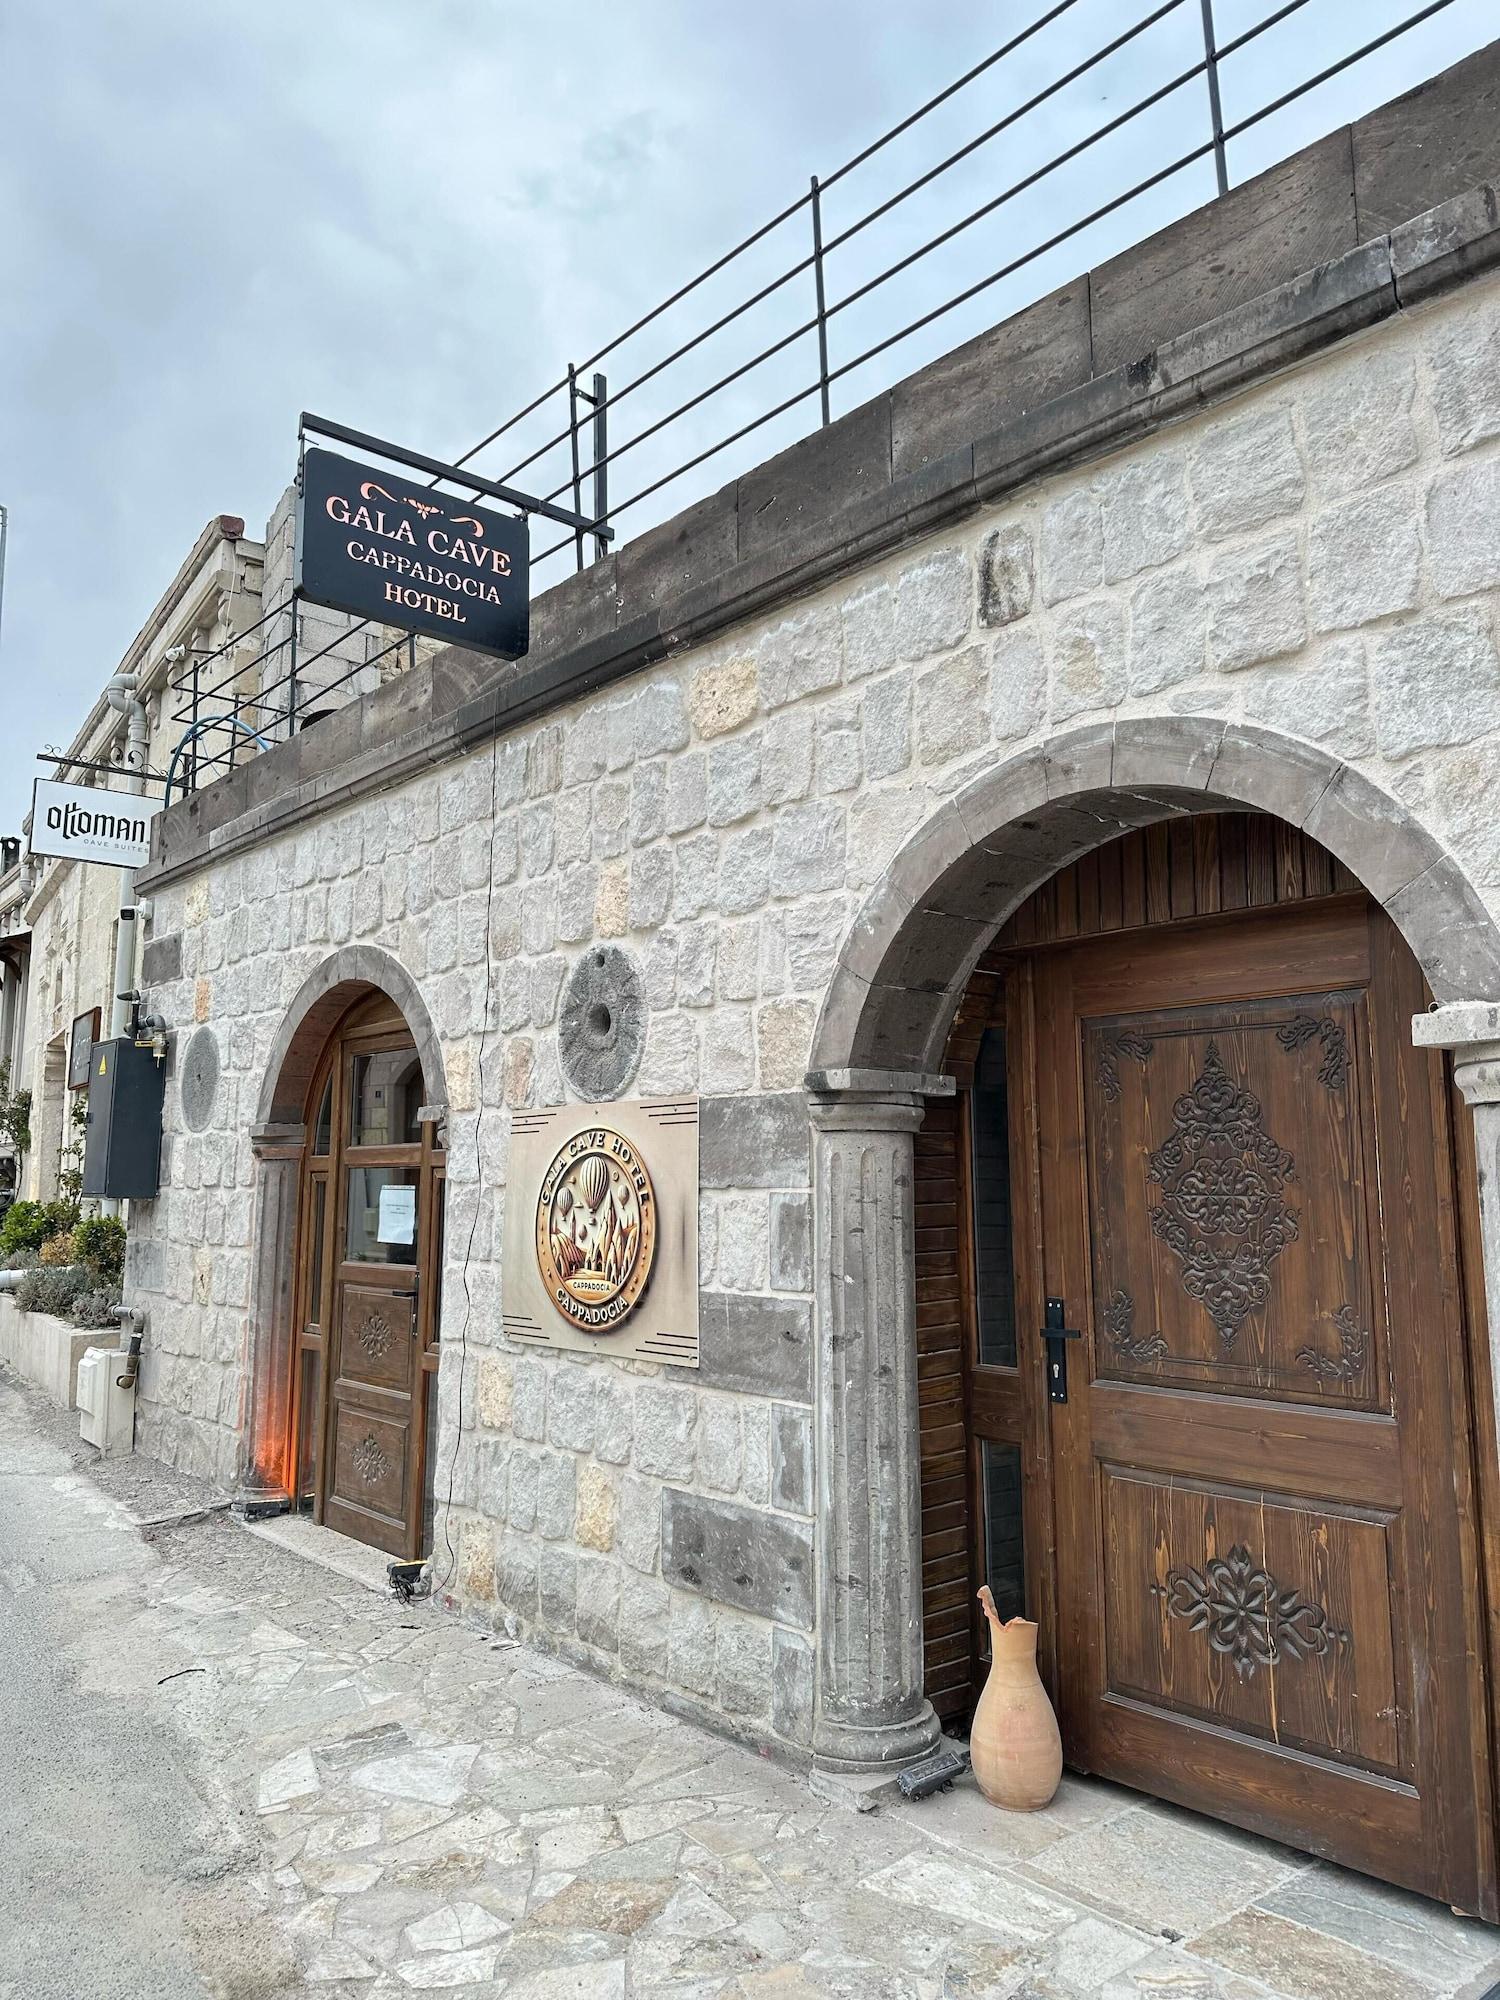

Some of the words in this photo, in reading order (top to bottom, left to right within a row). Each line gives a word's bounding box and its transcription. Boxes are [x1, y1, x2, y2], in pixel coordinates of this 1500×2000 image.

[326, 496, 418, 546] GALA
[427, 530, 512, 577] CAVE
[346, 541, 502, 605] CAPPADOCIA
[384, 582, 467, 623] HOTEL
[83, 838, 110, 848] CAVE
[114, 843, 149, 854] SUITES
[541, 1155, 568, 1205] GALA
[568, 1131, 606, 1157] CAVE
[611, 1136, 650, 1206] HOTEL
[556, 1288, 629, 1324] CAPPADOCIA
[573, 1281, 611, 1292] CAPPADOCIA
